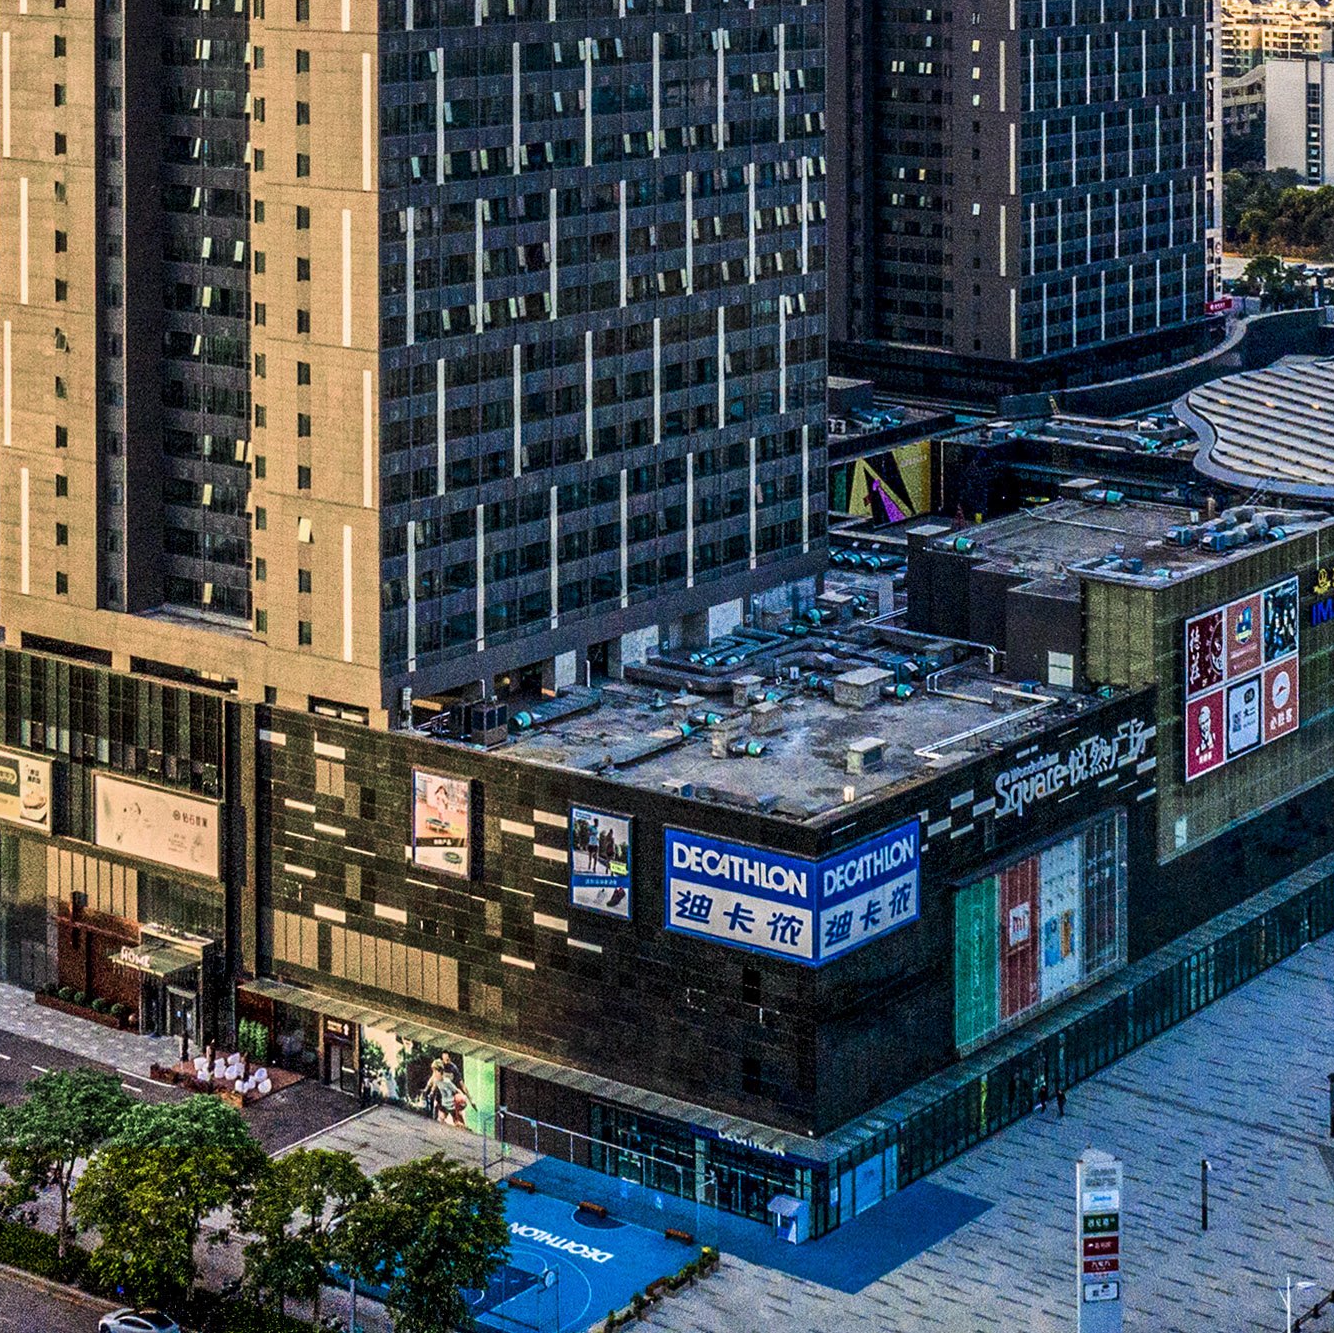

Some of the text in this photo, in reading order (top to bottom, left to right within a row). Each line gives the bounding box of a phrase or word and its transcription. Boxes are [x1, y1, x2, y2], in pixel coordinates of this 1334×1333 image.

[1068, 719, 1146, 786] 悦然广场
[994, 764, 1065, 819] Square
[672, 841, 808, 898] DECATHLON
[823, 834, 915, 898] DECATHLON
[675, 889, 804, 947] 迪卡侬
[824, 882, 912, 948] 迪卡侬
[510, 1221, 615, 1264] DECATHLON
